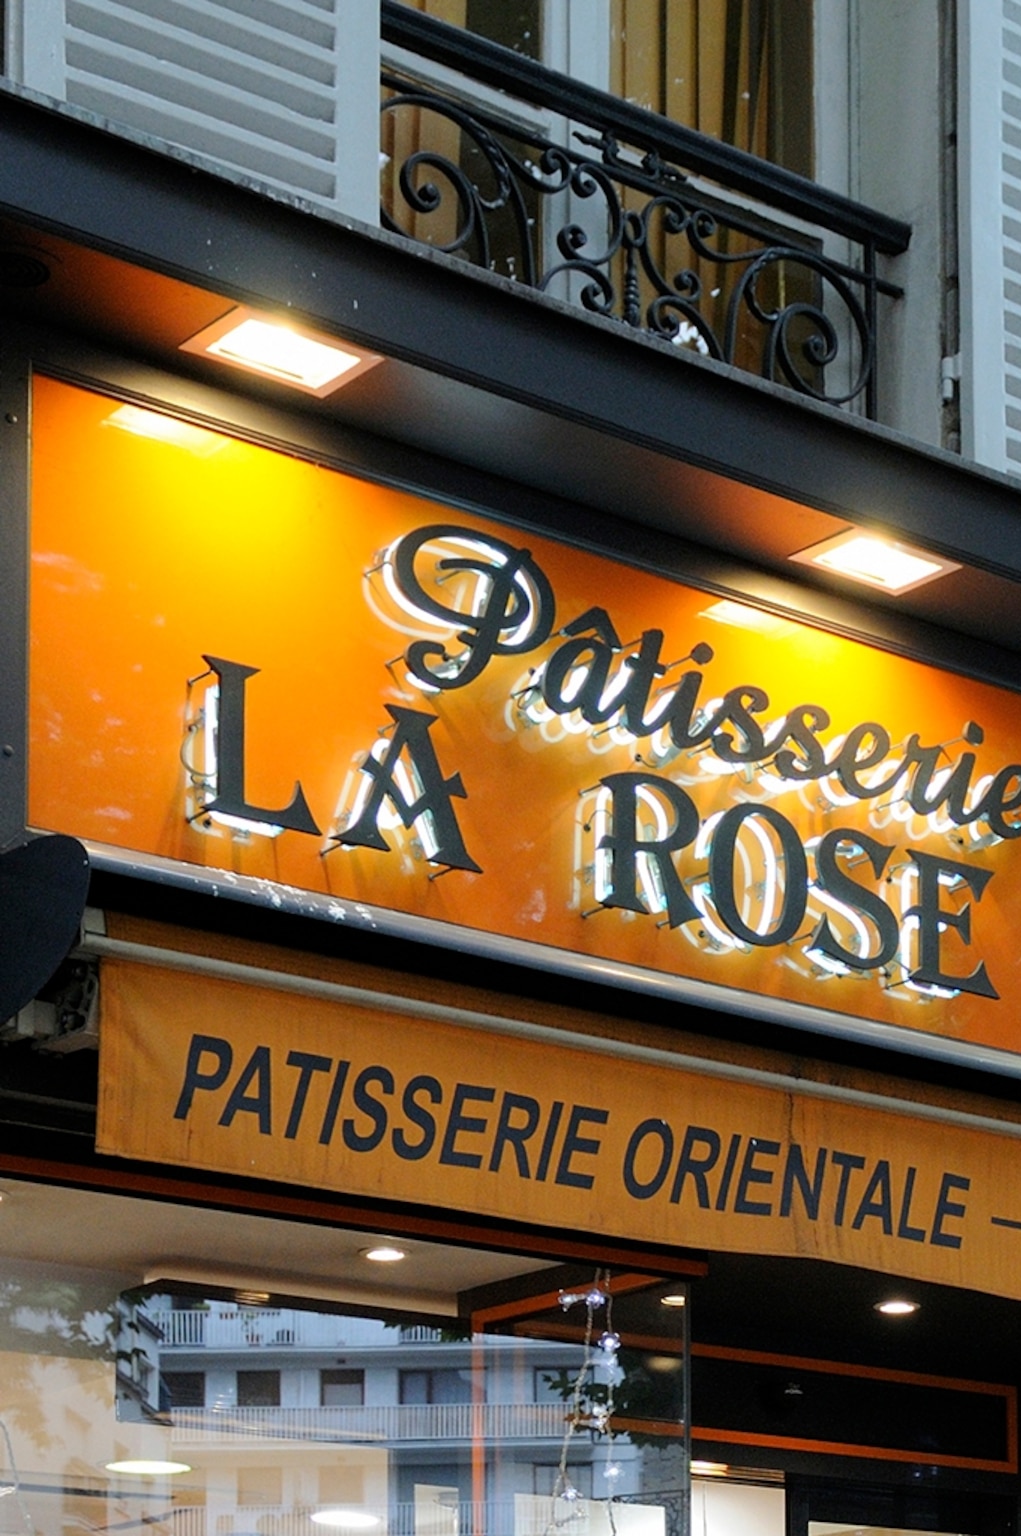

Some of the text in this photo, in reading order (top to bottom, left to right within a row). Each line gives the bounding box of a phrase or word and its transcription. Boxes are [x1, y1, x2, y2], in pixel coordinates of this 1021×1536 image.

[202, 653, 483, 875] LA
[598, 771, 1000, 999] ROSE
[174, 1034, 609, 1190] PATISSERIE
[622, 1118, 971, 1249] ORIENTALE
